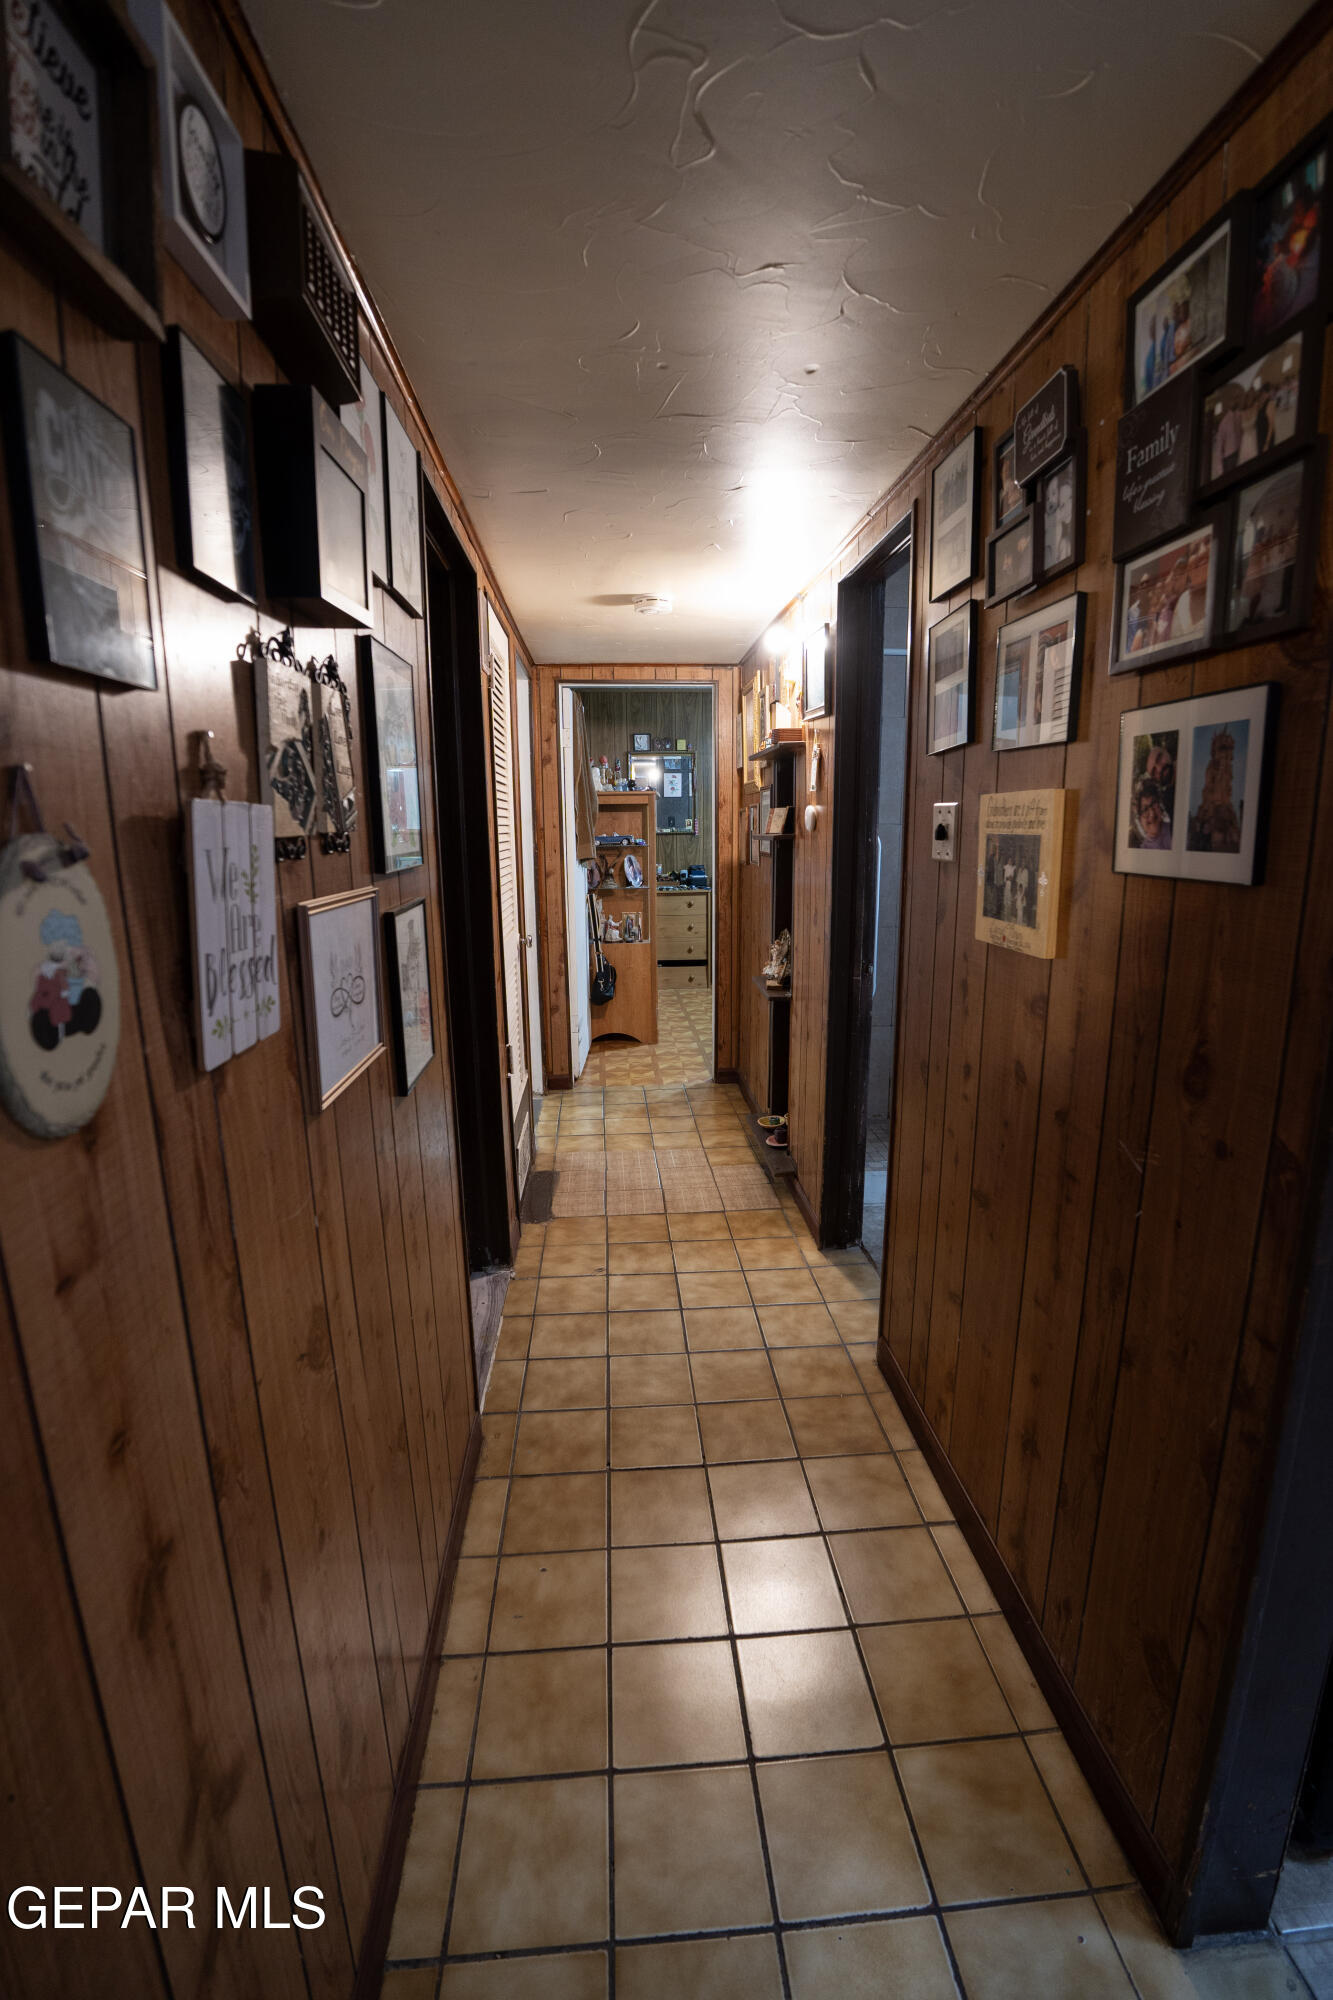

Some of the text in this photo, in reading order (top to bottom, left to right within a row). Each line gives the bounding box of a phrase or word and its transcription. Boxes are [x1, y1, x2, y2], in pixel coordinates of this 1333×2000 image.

[1126, 420, 1181, 475] Family
[205, 846, 238, 903] We
[230, 904, 262, 954] Are
[204, 934, 279, 1017] Blessed
